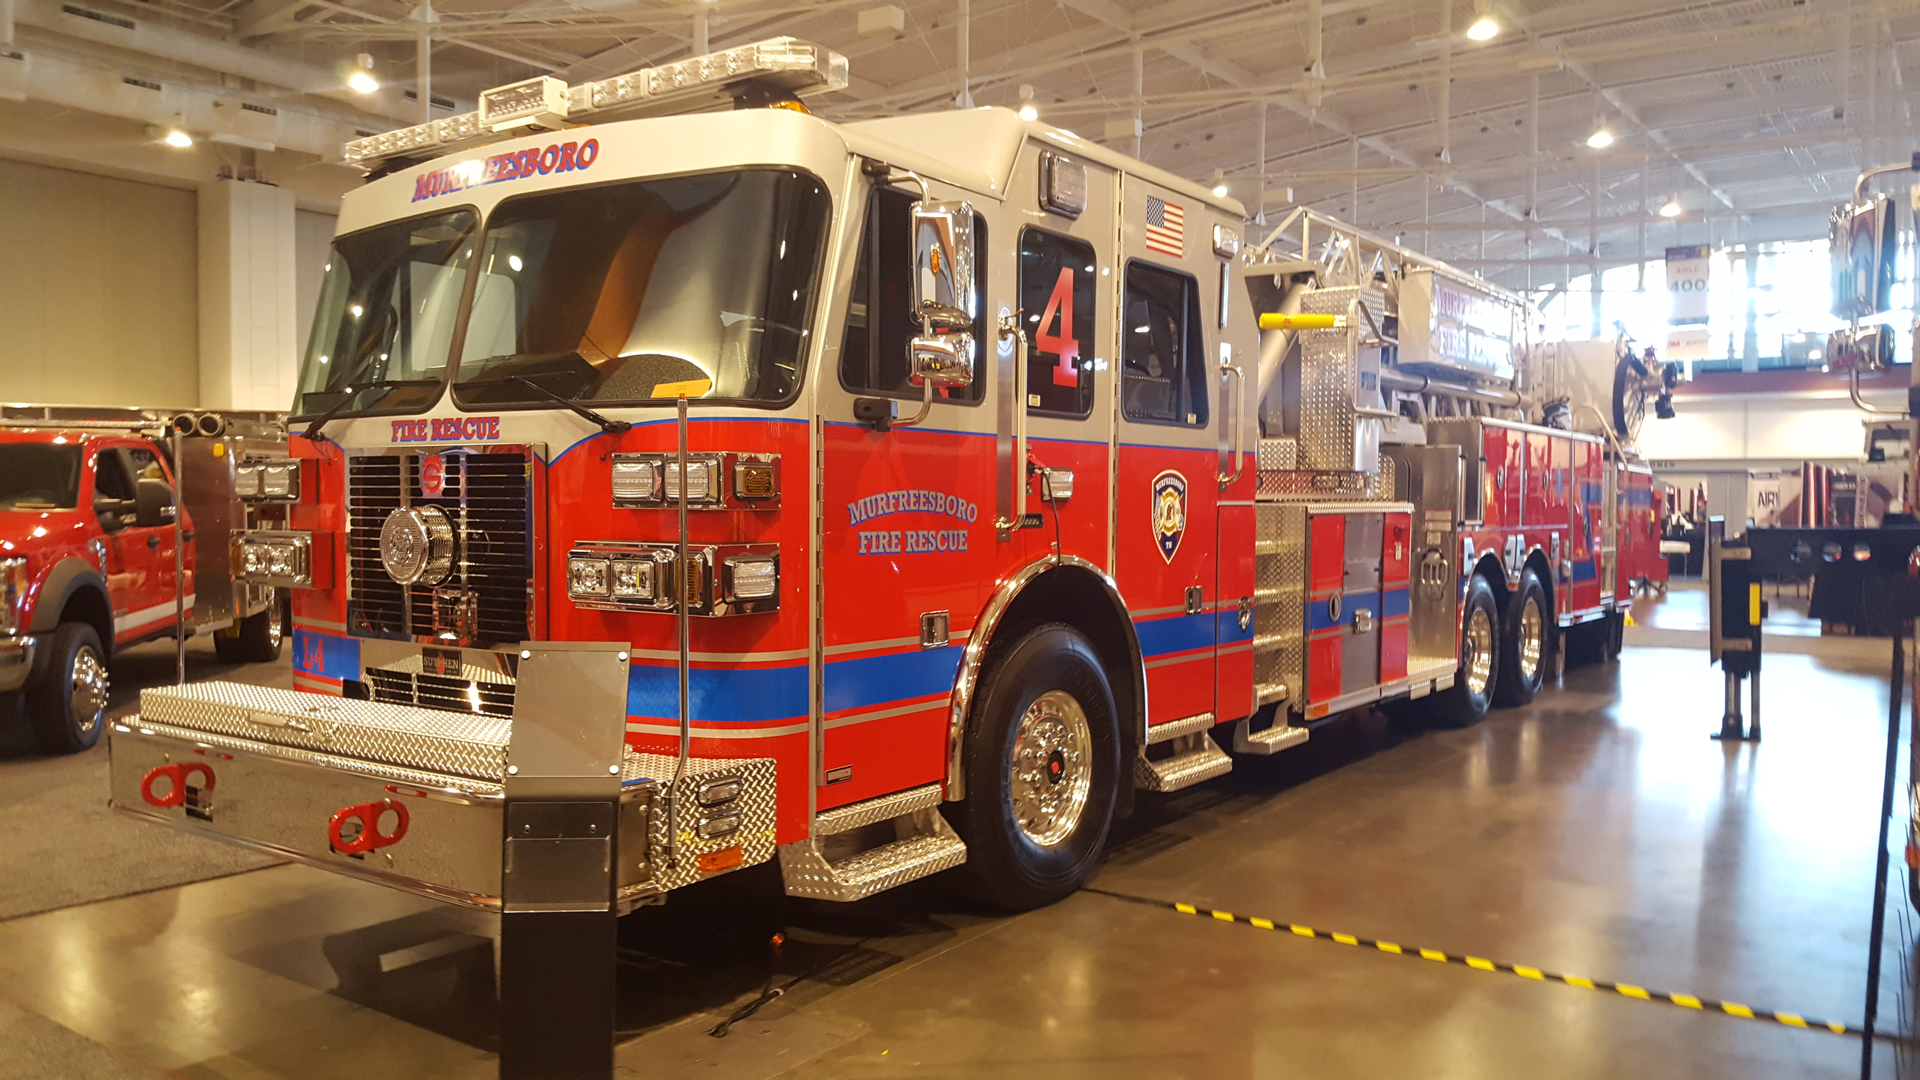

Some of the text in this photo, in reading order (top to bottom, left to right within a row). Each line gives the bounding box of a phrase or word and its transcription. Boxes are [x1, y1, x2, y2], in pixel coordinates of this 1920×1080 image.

[412, 138, 599, 203] MUREESBORO
[1670, 279, 1706, 292] 400
[1035, 266, 1079, 388] 4
[391, 416, 500, 442] FIRE RESCUE
[847, 489, 978, 527] MURFREESBORO
[858, 530, 968, 555] FIRE RESCUE
[302, 635, 325, 672] L4
